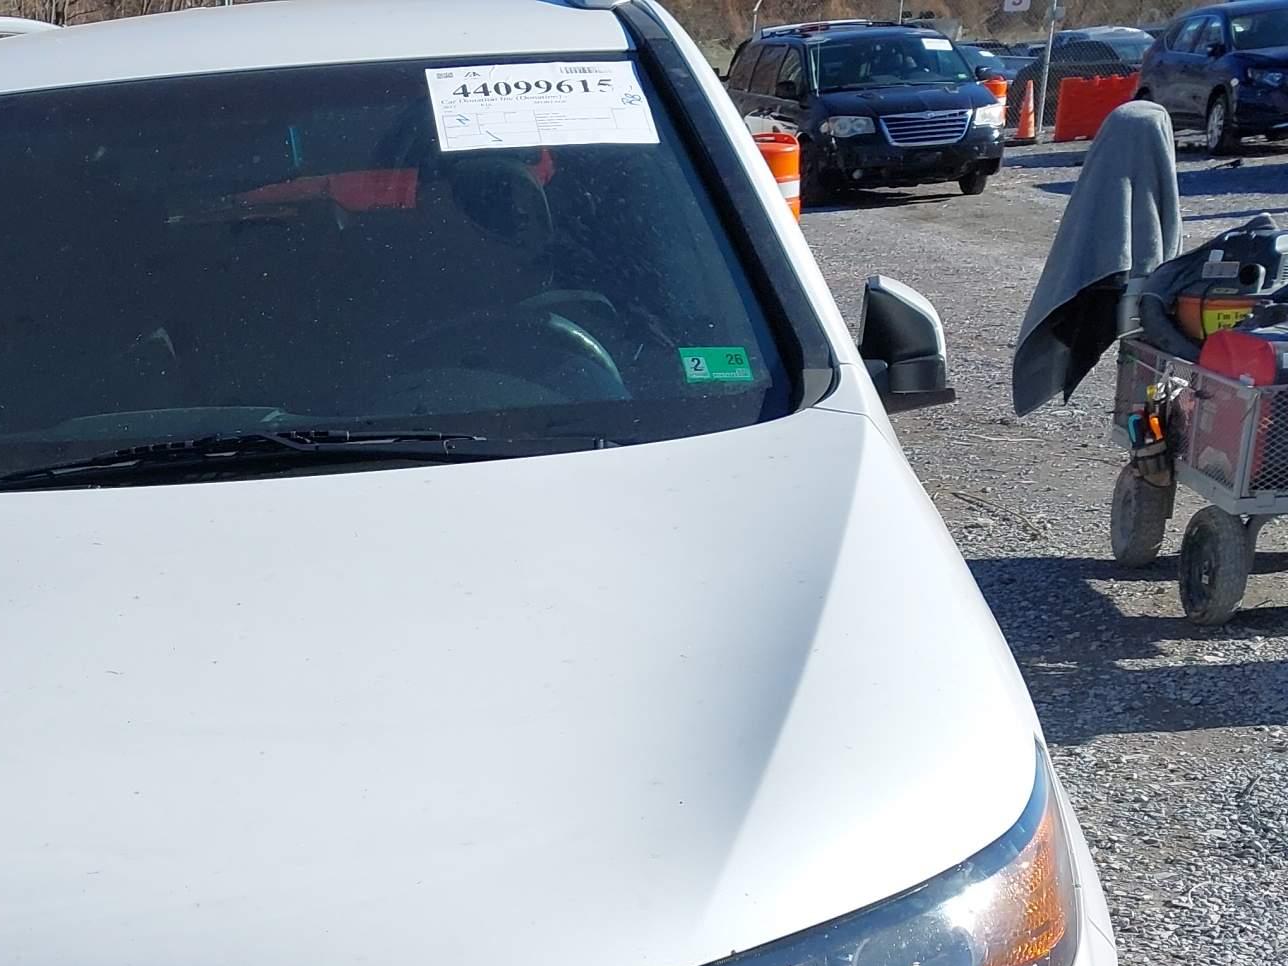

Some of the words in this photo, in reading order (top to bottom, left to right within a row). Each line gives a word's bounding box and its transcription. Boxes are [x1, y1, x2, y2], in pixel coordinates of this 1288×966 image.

[452, 79, 613, 98] 44099615
[691, 357, 704, 372] 2
[725, 353, 744, 366] 26
